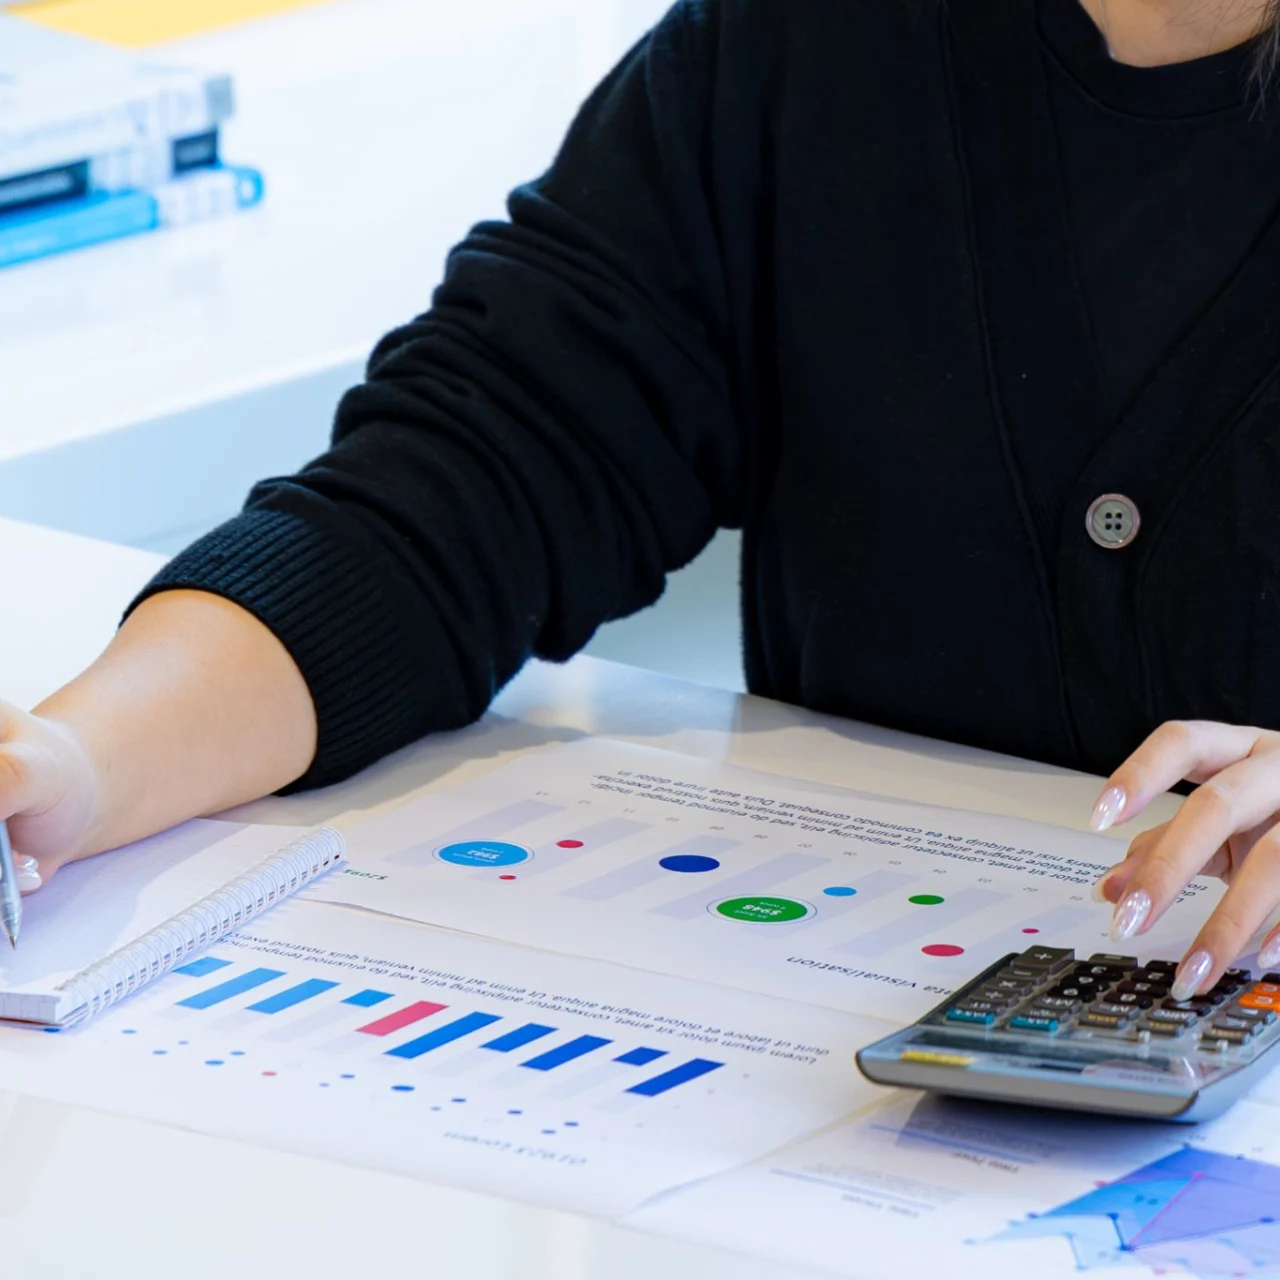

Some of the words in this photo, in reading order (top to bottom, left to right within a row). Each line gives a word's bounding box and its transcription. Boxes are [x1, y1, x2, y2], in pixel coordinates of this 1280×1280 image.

[617, 770, 632, 778] in
[635, 773, 671, 786] dolor
[593, 774, 651, 790] exercita-
[674, 780, 706, 793] irure
[589, 782, 633, 797] incidi-
[653, 786, 708, 801] nostrud
[710, 788, 741, 798] aute
[634, 790, 686, 806] tempor
[710, 797, 740, 807] quis
[745, 794, 775, 806] Duis
[689, 802, 748, 817] eiusmod
[744, 804, 794, 819] veniam,
[778, 801, 851, 821] consequat.
[750, 814, 769, 822] do
[771, 818, 797, 827] sed
[798, 814, 842, 828] minim
[800, 822, 826, 832] elit,
[845, 823, 864, 833] ad
[854, 816, 922, 836] commodo
[828, 828, 900, 847] adipiscing
[867, 828, 902, 839] enim
[904, 835, 922, 843] Ut
[947, 834, 962, 842] ex
[926, 839, 971, 854] aliqua.
[965, 838, 1015, 853] aliquip
[1018, 848, 1034, 856] ut
[902, 843, 984, 863] consectetur
[974, 848, 1023, 862] magna
[1036, 852, 1063, 862] nisi
[988, 860, 1026, 872] amet,
[1025, 858, 1073, 874] dolore
[1067, 858, 1110, 871] aboris
[1029, 868, 1048, 877] sit
[1050, 873, 1088, 884] dolor
[1075, 868, 1090, 877] et
[250, 944, 303, 961] tempor
[269, 940, 327, 956] nostrud
[328, 948, 360, 961] quis
[304, 954, 366, 971] eiusmod
[362, 954, 415, 971] veniam,
[369, 966, 388, 976] do
[389, 971, 417, 982] sed
[418, 968, 465, 982] minim
[786, 956, 918, 988] visualisation
[419, 977, 447, 990] elit,
[467, 977, 487, 987] ad
[488, 982, 526, 996] enim
[450, 982, 523, 1004] adipiscing
[526, 992, 546, 1001] Ut
[552, 994, 598, 1010] aliqua.
[525, 999, 611, 1022] consectetur
[600, 1005, 651, 1020] magna
[614, 1017, 654, 1031] amet,
[652, 1016, 702, 1032] dolore
[705, 1026, 721, 1034] et
[656, 1027, 676, 1036] sit
[677, 1031, 718, 1045] dolor
[723, 1030, 772, 1046] labore
[720, 1040, 768, 1054] ipsum
[774, 1041, 791, 1049] ut
[793, 1042, 830, 1057] dunt
[769, 1049, 818, 1066] Lorem
